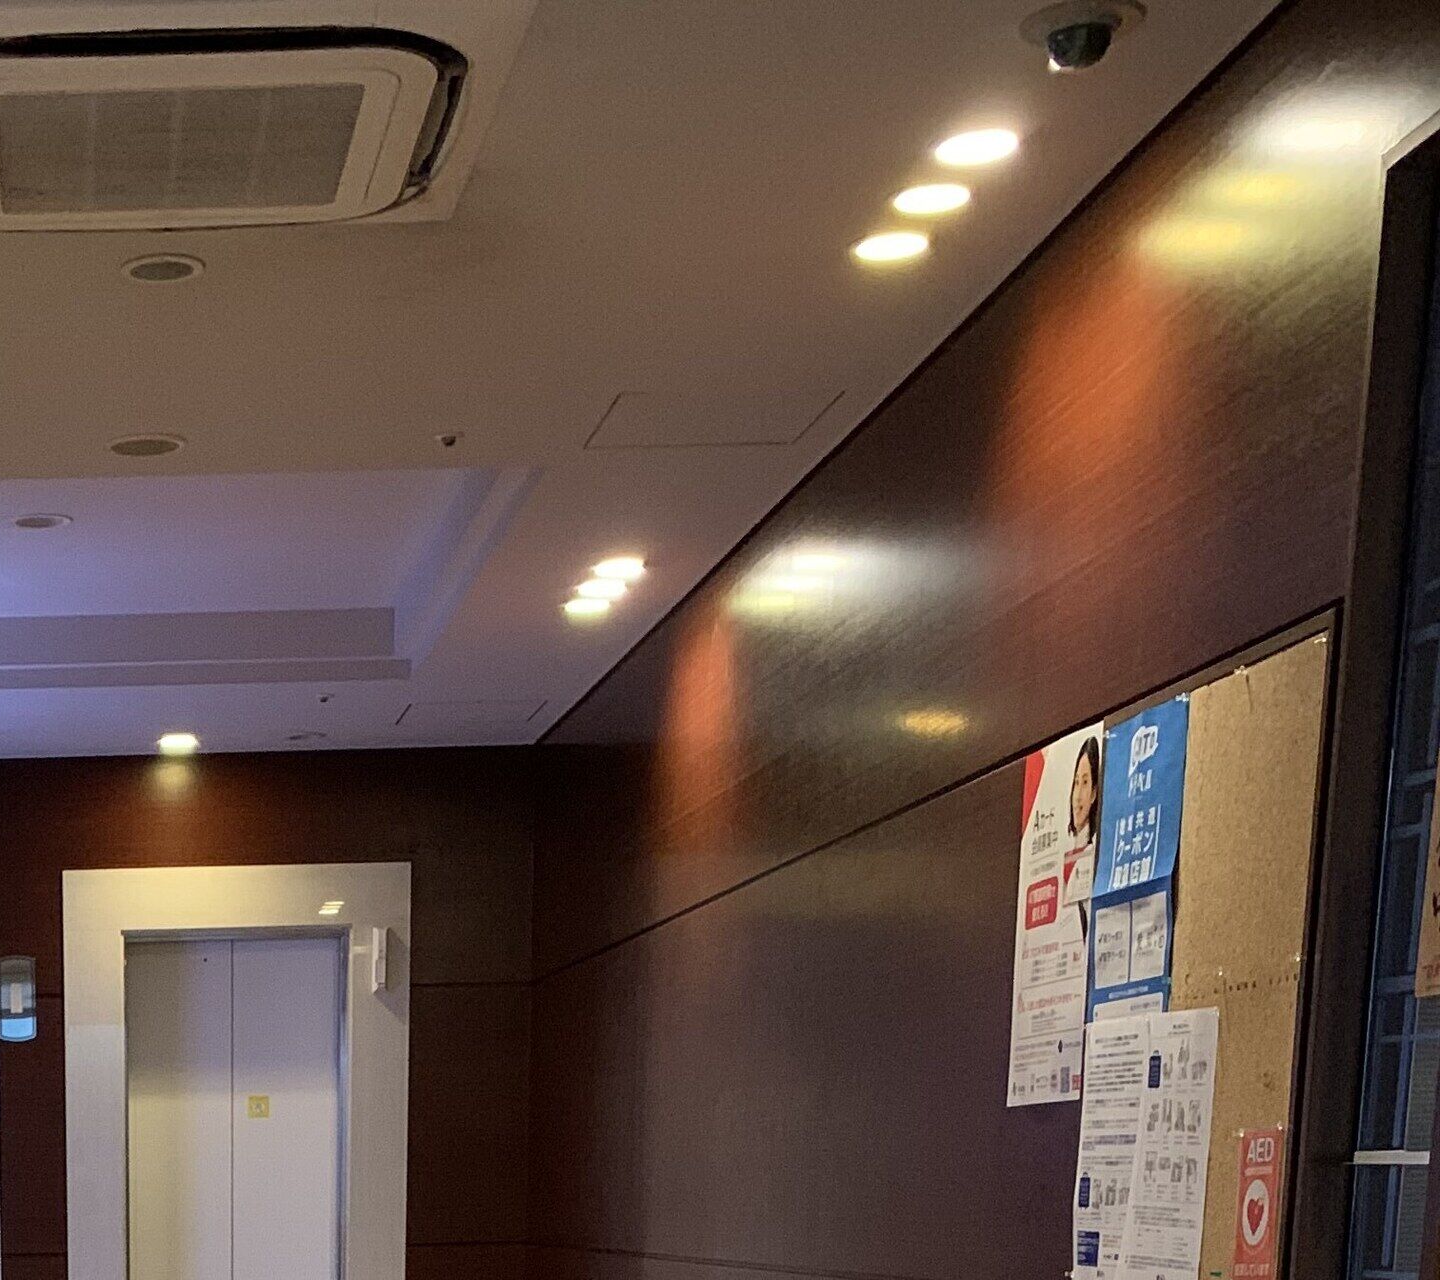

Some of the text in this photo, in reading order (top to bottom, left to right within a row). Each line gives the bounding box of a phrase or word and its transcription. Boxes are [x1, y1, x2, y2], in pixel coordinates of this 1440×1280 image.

[1116, 830, 1155, 862] クーポン
[1247, 1137, 1275, 1163] AED
